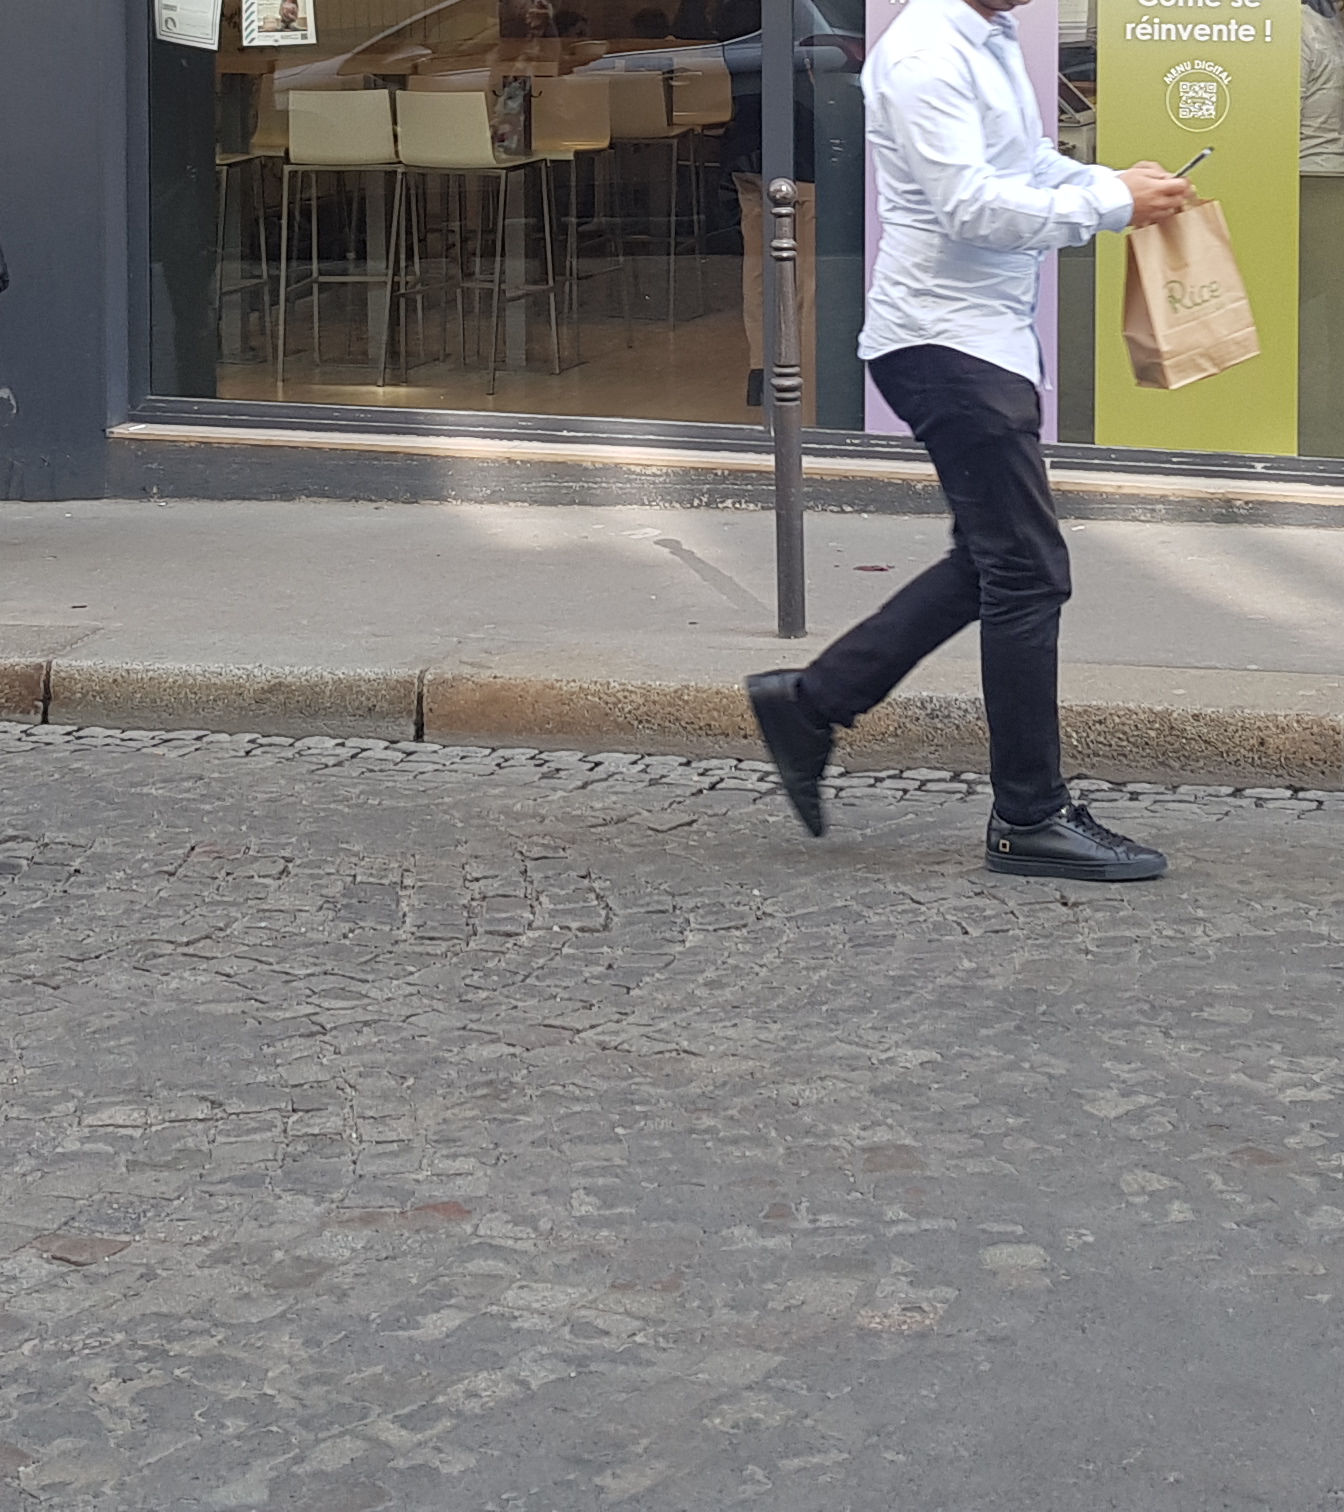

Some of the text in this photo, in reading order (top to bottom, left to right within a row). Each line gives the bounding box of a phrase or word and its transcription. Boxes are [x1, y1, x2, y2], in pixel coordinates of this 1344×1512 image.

[1125, 15, 1256, 42] réinvente
[1163, 59, 1232, 85] MENU DIGITAL
